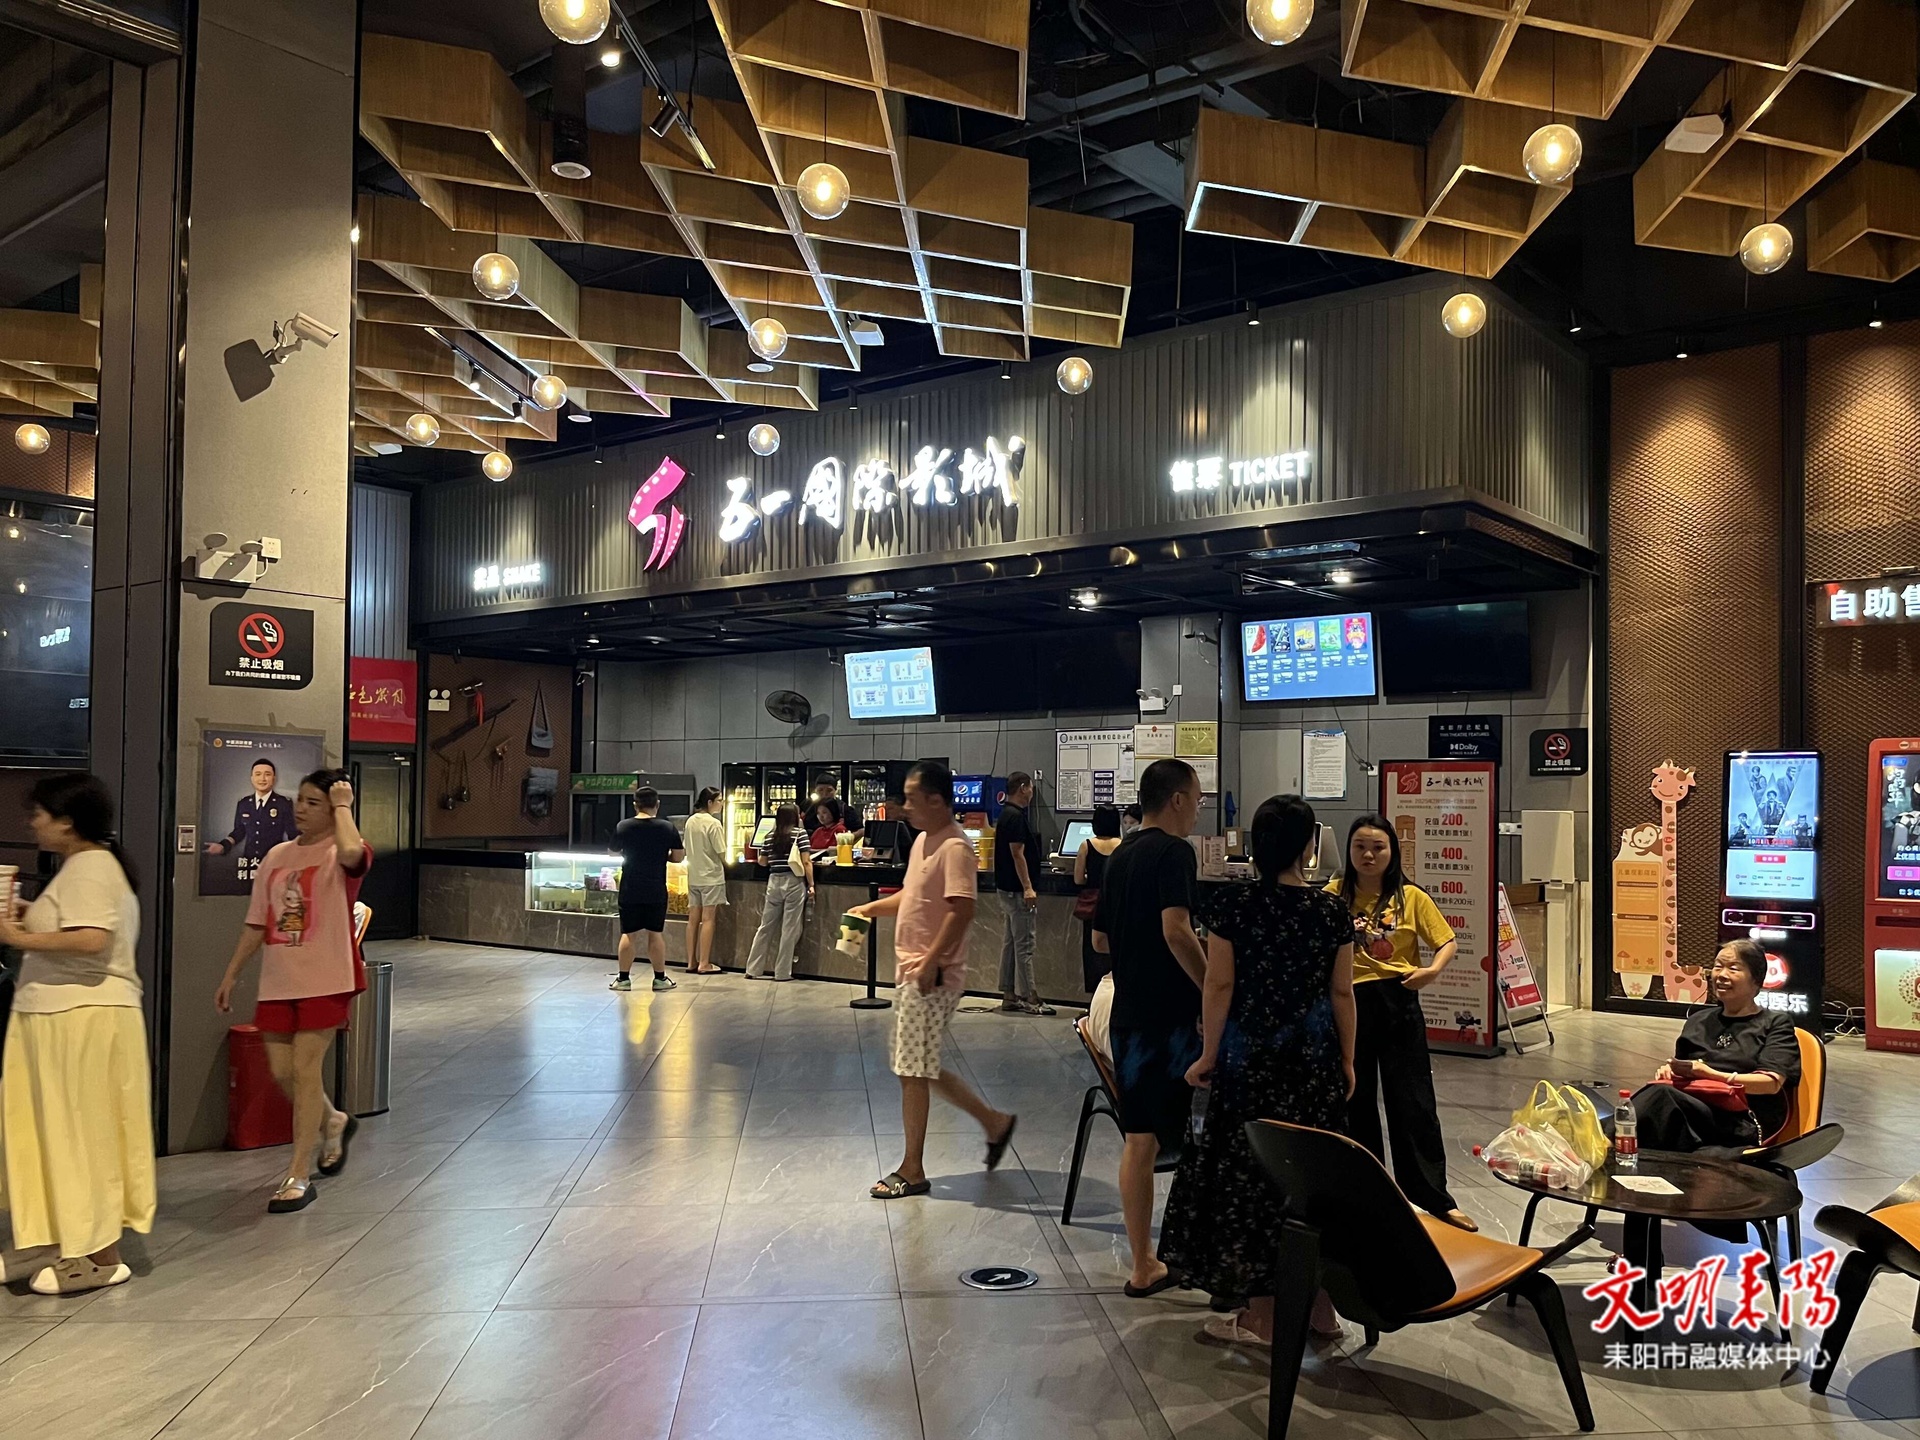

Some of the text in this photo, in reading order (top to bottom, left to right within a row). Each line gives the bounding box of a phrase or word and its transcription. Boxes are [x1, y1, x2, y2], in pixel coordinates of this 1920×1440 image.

[1229, 451, 1309, 487] TICKET
[239, 657, 284, 671] 禁止吸烟
[1459, 743, 1479, 751] Dolby
[238, 857, 260, 867] 防火
